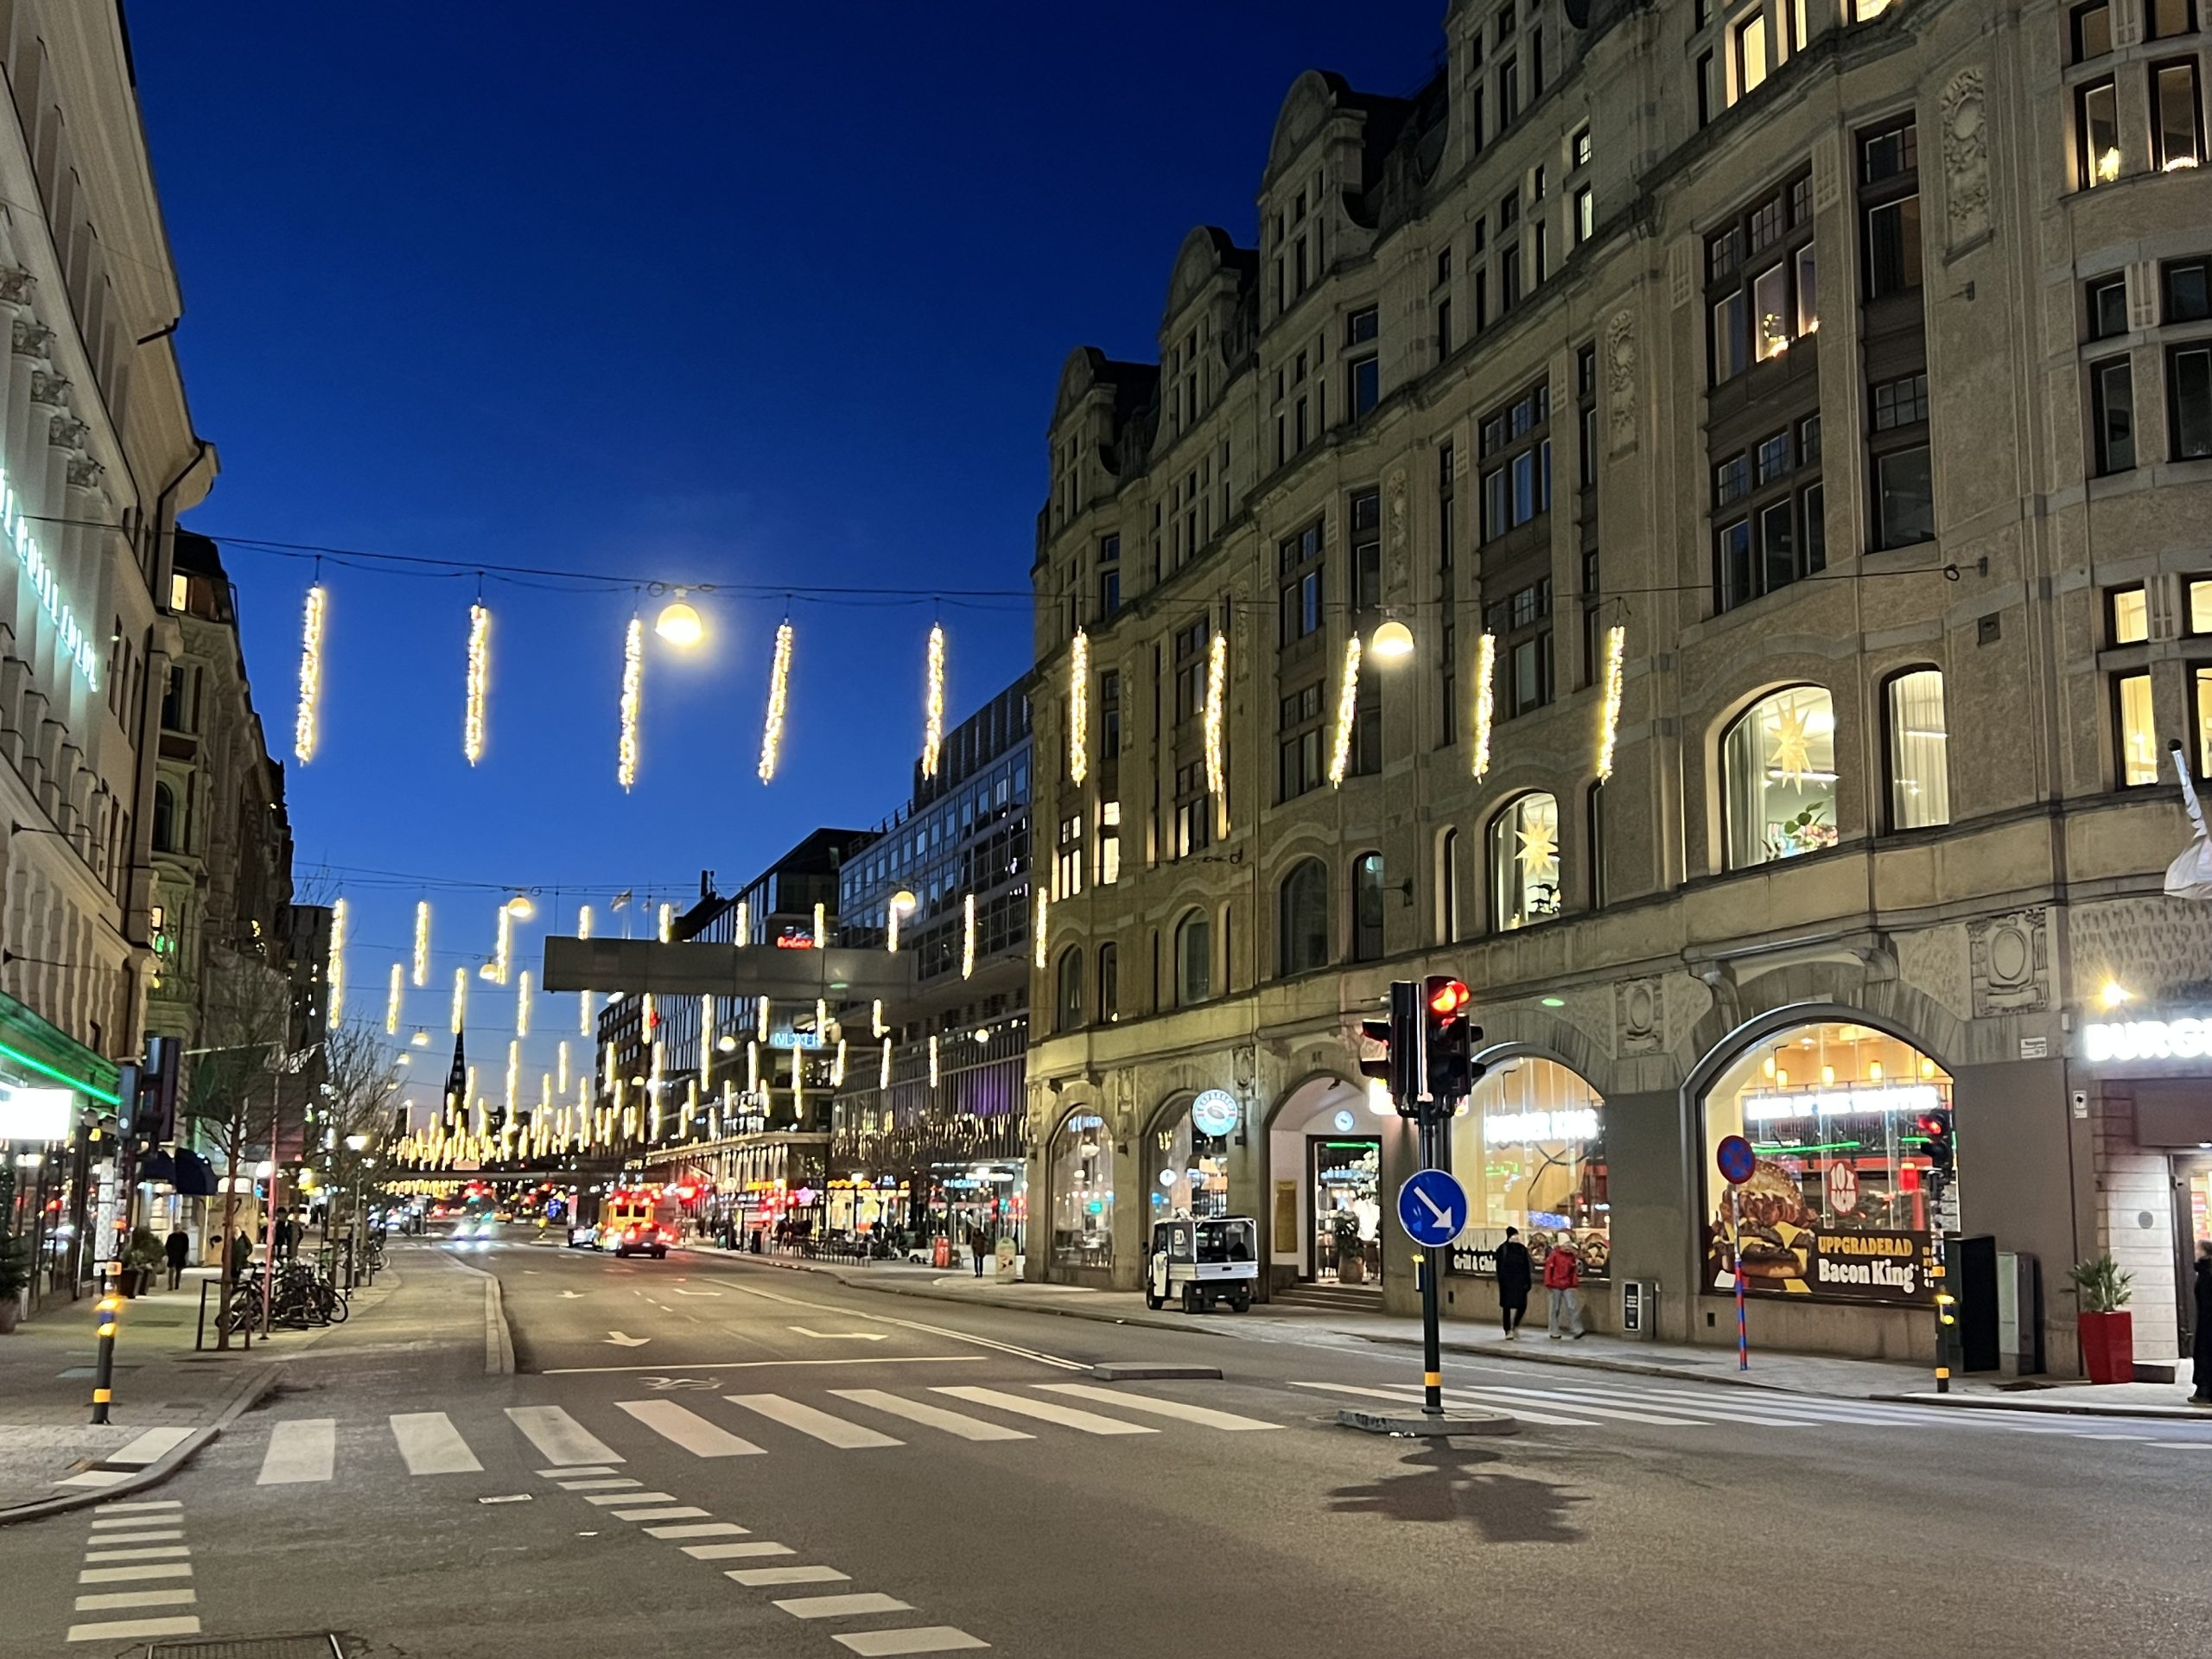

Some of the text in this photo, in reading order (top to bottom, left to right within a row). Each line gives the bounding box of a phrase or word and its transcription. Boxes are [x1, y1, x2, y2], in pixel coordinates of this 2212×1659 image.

[1817, 1236, 1913, 1256] UPPGRADERAD
[1453, 1254, 1471, 1270] Grill
[1471, 1255, 1478, 1271] &
[1818, 1258, 1870, 1285] Bacon
